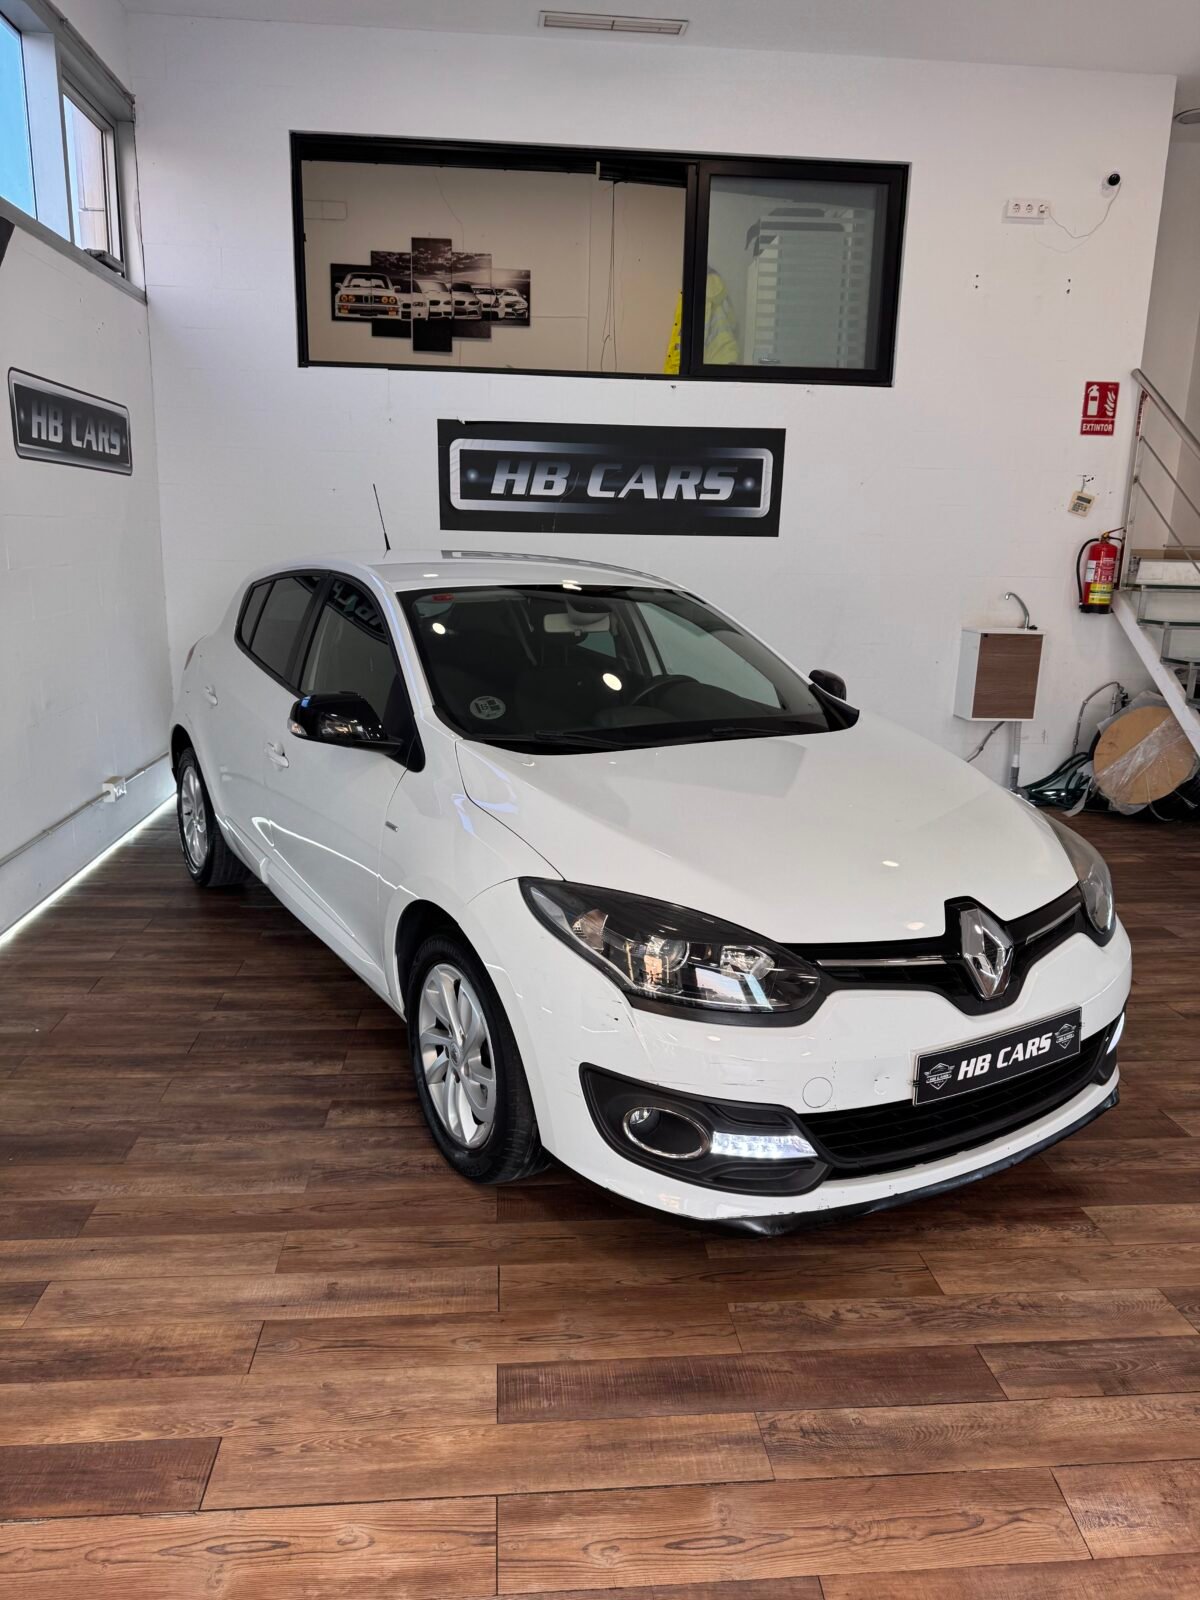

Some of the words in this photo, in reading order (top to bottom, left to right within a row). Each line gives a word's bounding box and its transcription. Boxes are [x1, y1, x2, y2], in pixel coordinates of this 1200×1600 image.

[31, 400, 64, 443] HB
[70, 410, 121, 456] CARS
[1082, 423, 1113, 432] EXTINTOR
[490, 458, 572, 497] HB
[586, 462, 739, 501] CARS
[957, 1053, 992, 1081] HB
[996, 1032, 1053, 1069] CARS
